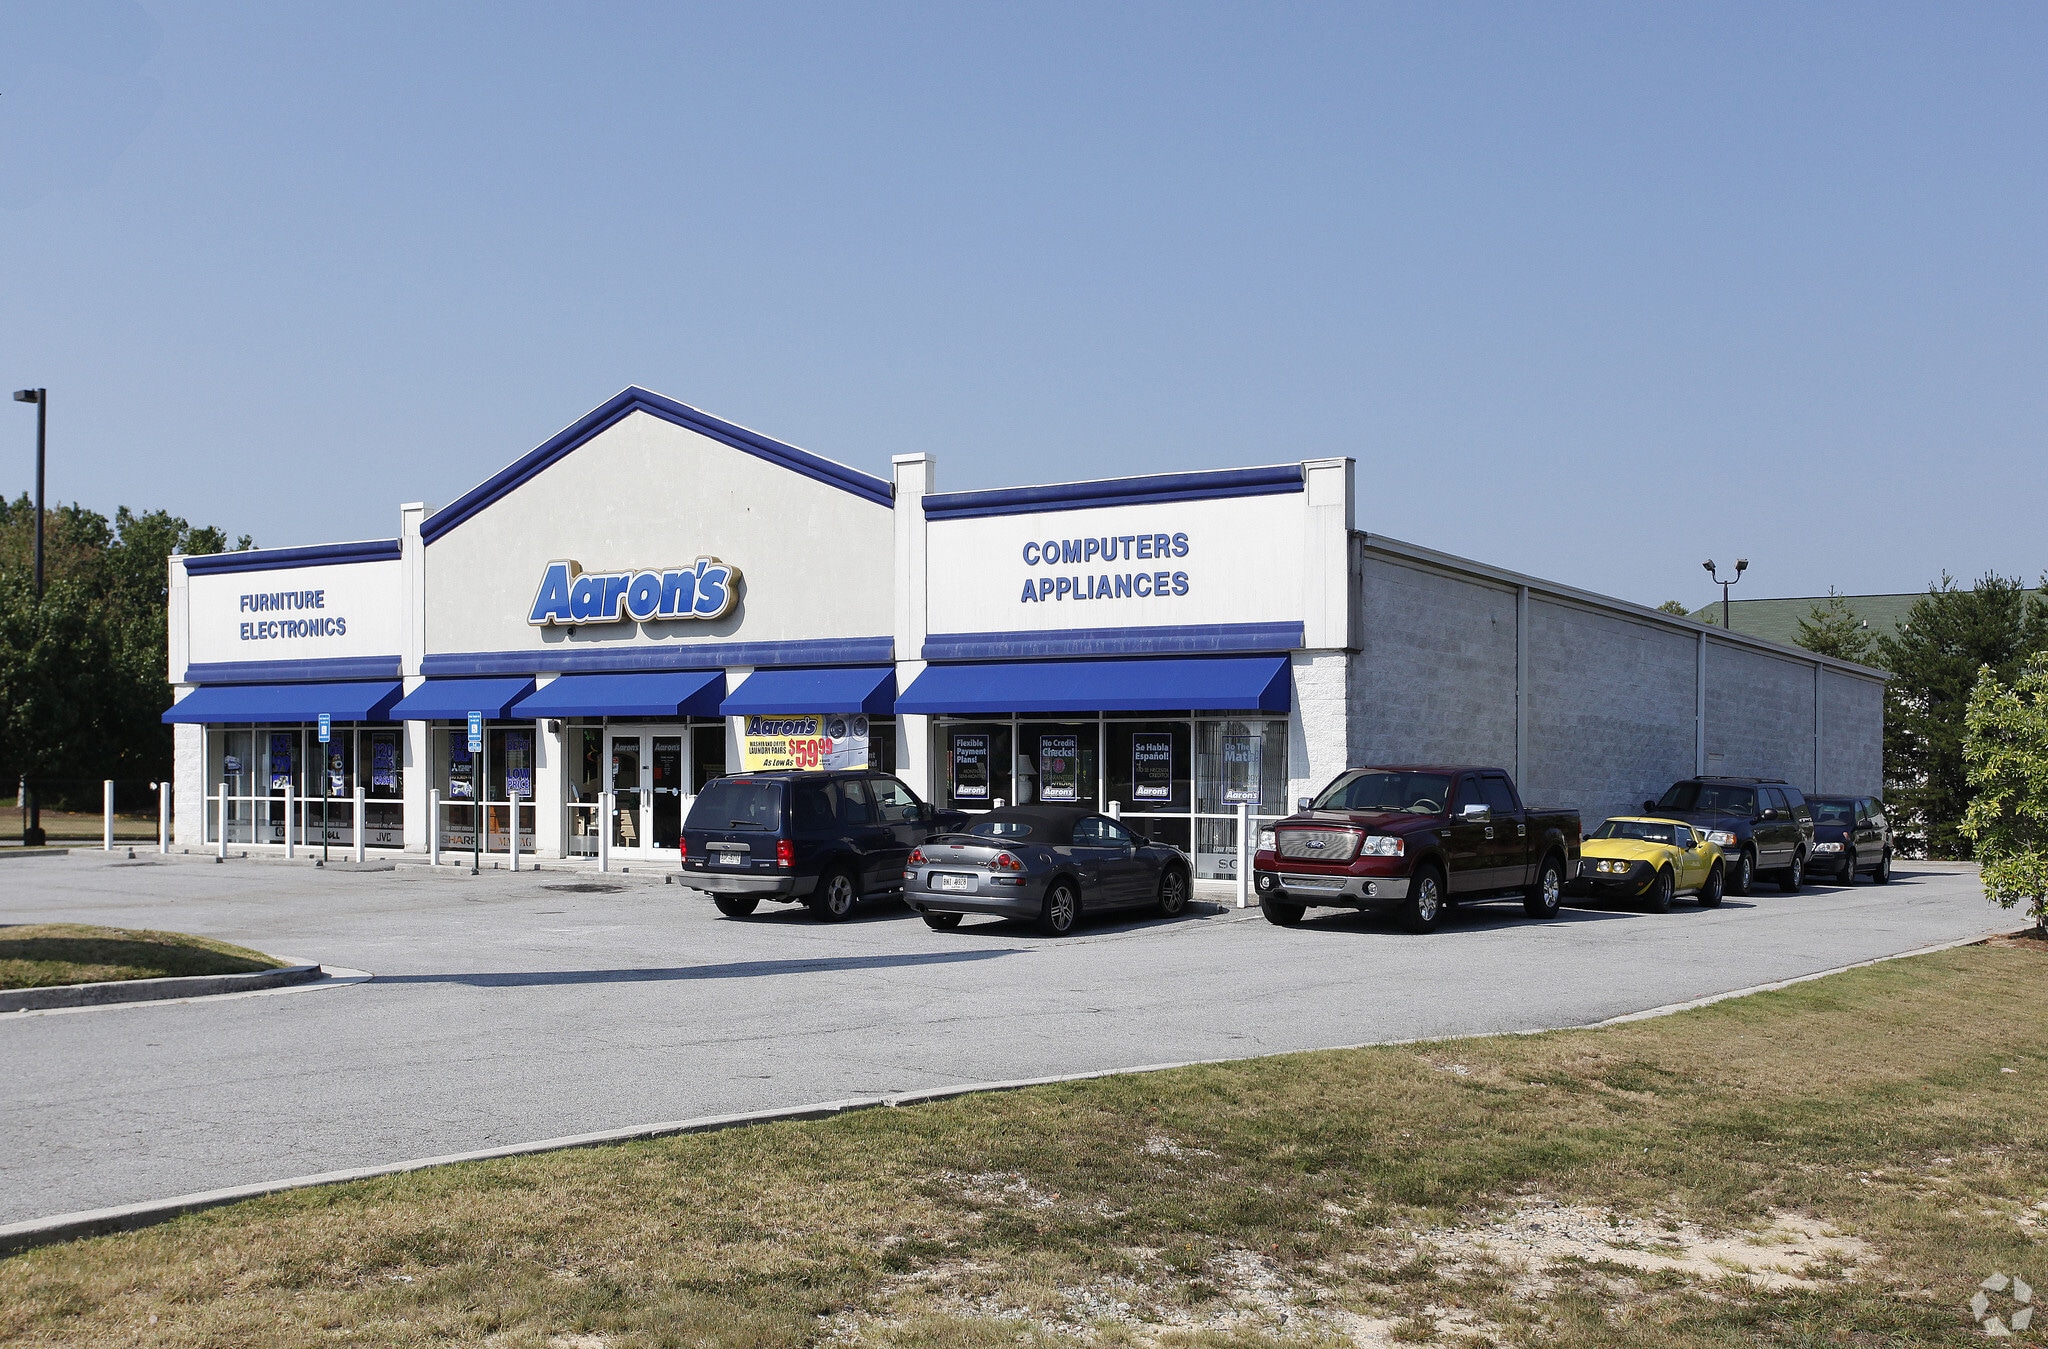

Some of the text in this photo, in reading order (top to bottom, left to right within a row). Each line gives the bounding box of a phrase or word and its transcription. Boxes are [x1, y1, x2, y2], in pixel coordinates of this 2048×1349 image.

[1022, 532, 1190, 566] COMPUTERS
[528, 557, 732, 624] Aaron's
[1021, 571, 1190, 603] APPLIANCES
[240, 590, 325, 613] FURNITURE
[240, 617, 347, 640] ELECTRONICS
[746, 716, 818, 736] Aaron's
[655, 743, 680, 751] Aaron's
[957, 739, 983, 747] Flexible
[1053, 739, 1074, 747] Credit
[1135, 743, 1169, 751] Se Habla
[1225, 743, 1250, 751] Do The
[374, 743, 393, 758] 120
[749, 746, 787, 755] LAUNDRY PAIRS
[957, 747, 986, 756] Payment
[1042, 747, 1074, 757] Checks!
[957, 755, 977, 763] Plans!
[1135, 752, 1169, 761] Español!
[1225, 751, 1259, 762] Math!
[508, 768, 530, 779] LOW
[508, 780, 530, 790] PRICE
[957, 784, 986, 795] Aaron's
[1136, 785, 1169, 796] Aaron's
[1043, 785, 1074, 797] Aaron's
[1225, 789, 1259, 800] Aaron's
[376, 832, 392, 842] JVC
